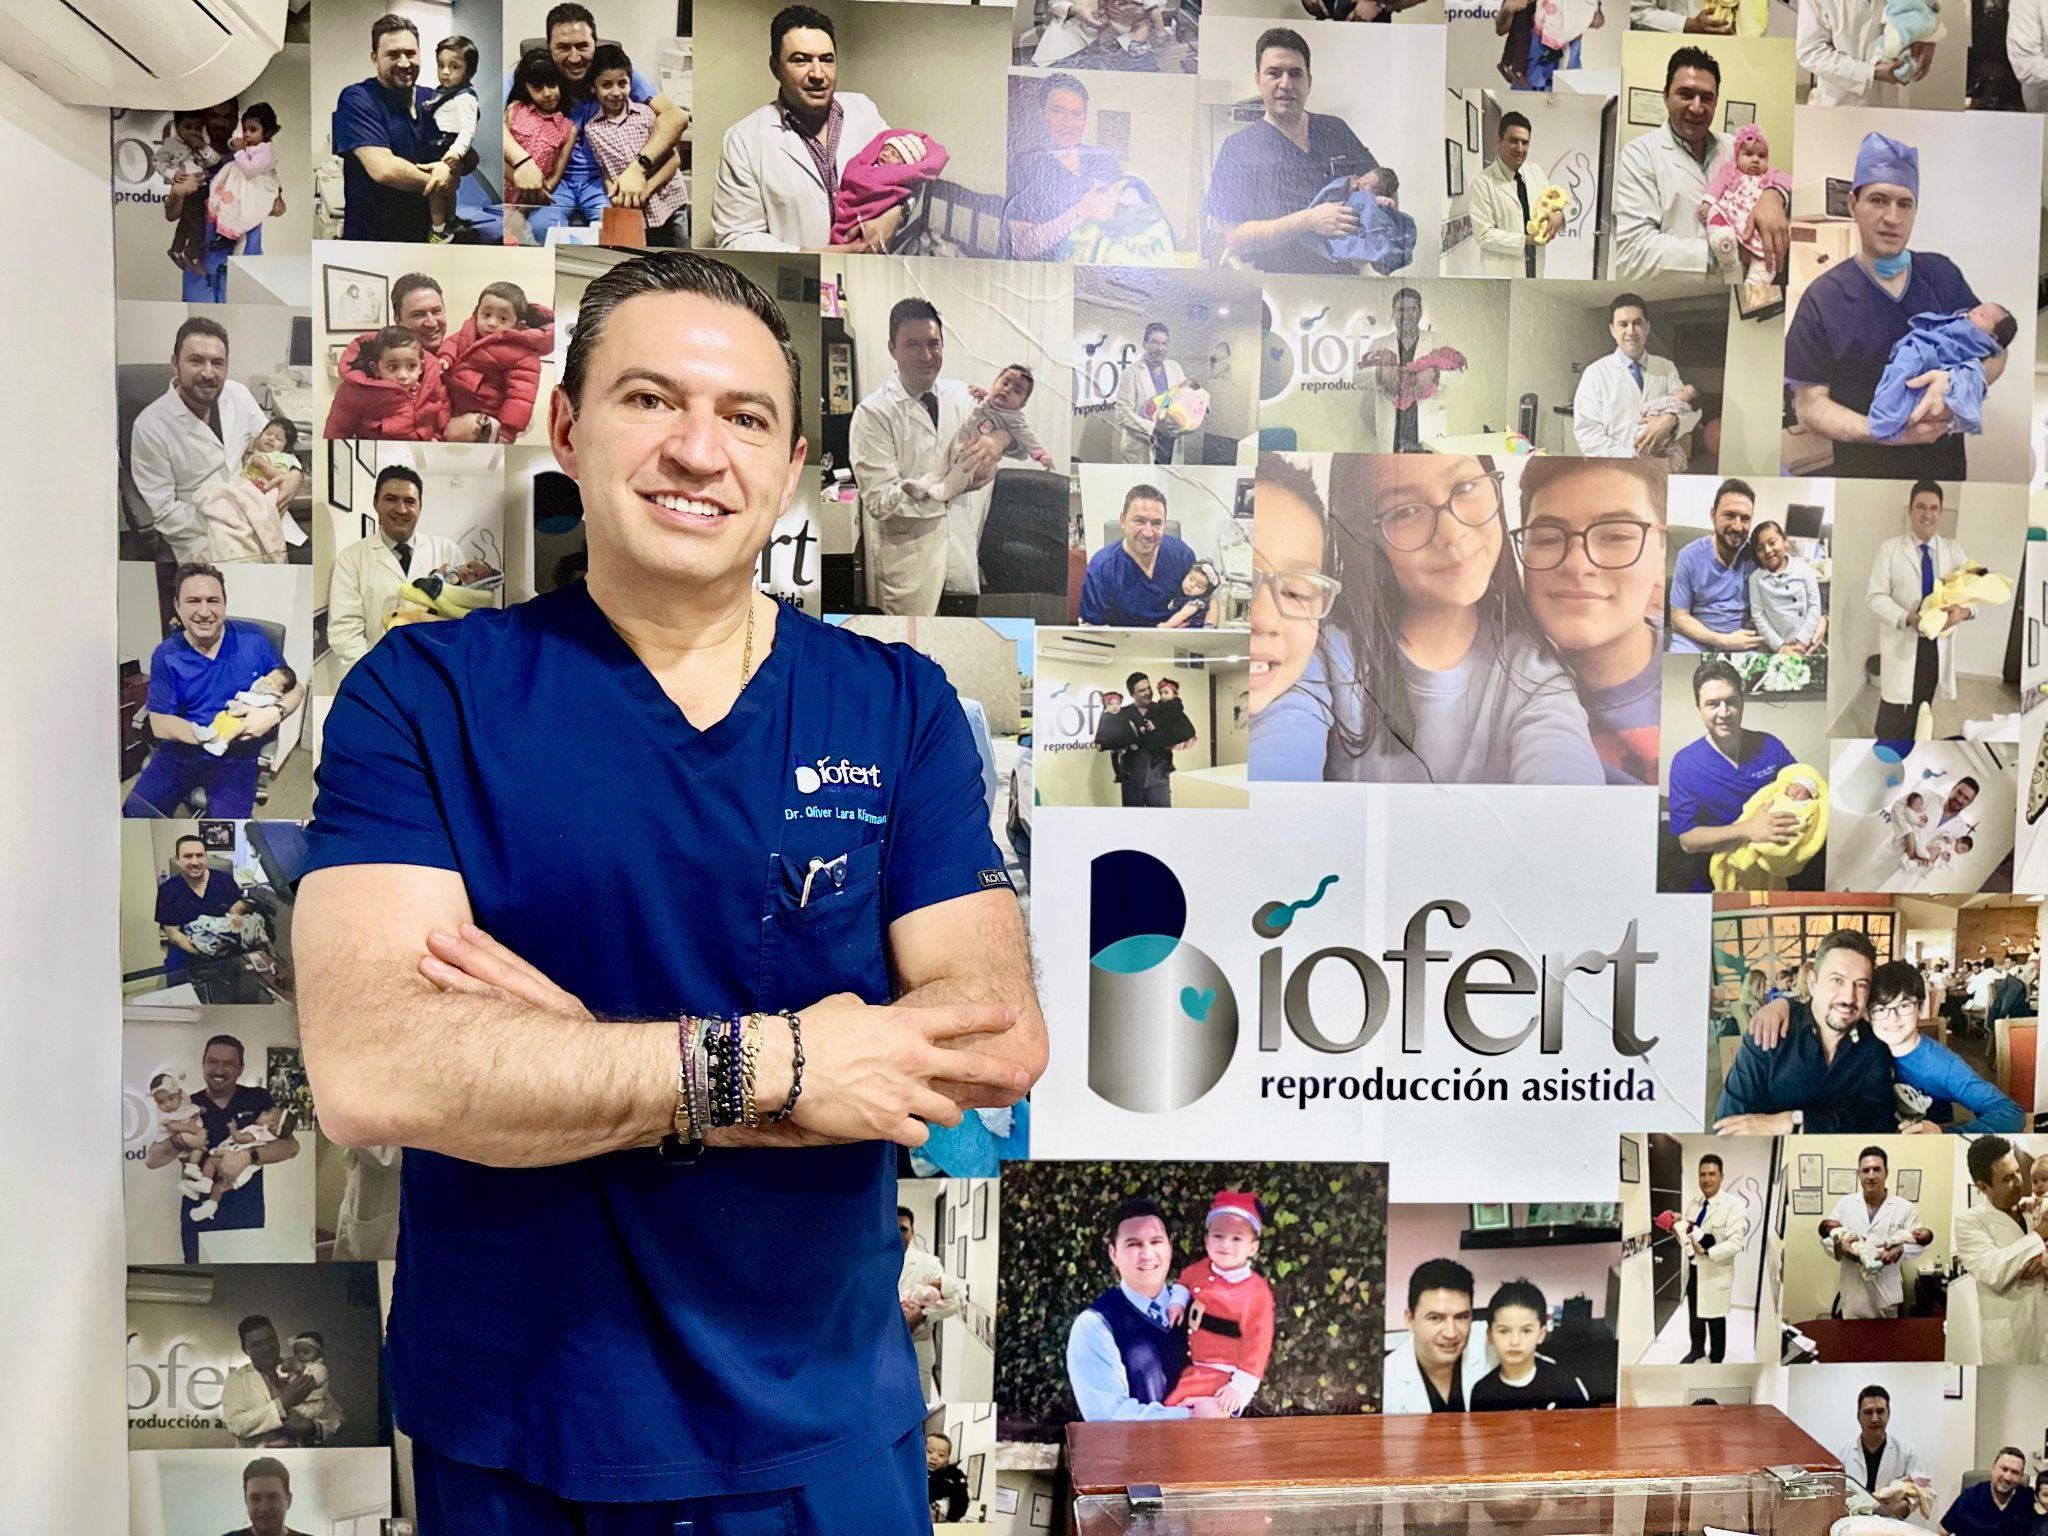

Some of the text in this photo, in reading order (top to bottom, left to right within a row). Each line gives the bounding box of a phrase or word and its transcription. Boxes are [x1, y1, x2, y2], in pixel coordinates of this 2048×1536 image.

[784, 808, 804, 820] Dr.
[805, 805, 833, 818] Oliver
[835, 806, 856, 820] Lara
[1088, 849, 1660, 1114] Biofert
[1260, 1067, 1656, 1110] reproducción asistida
